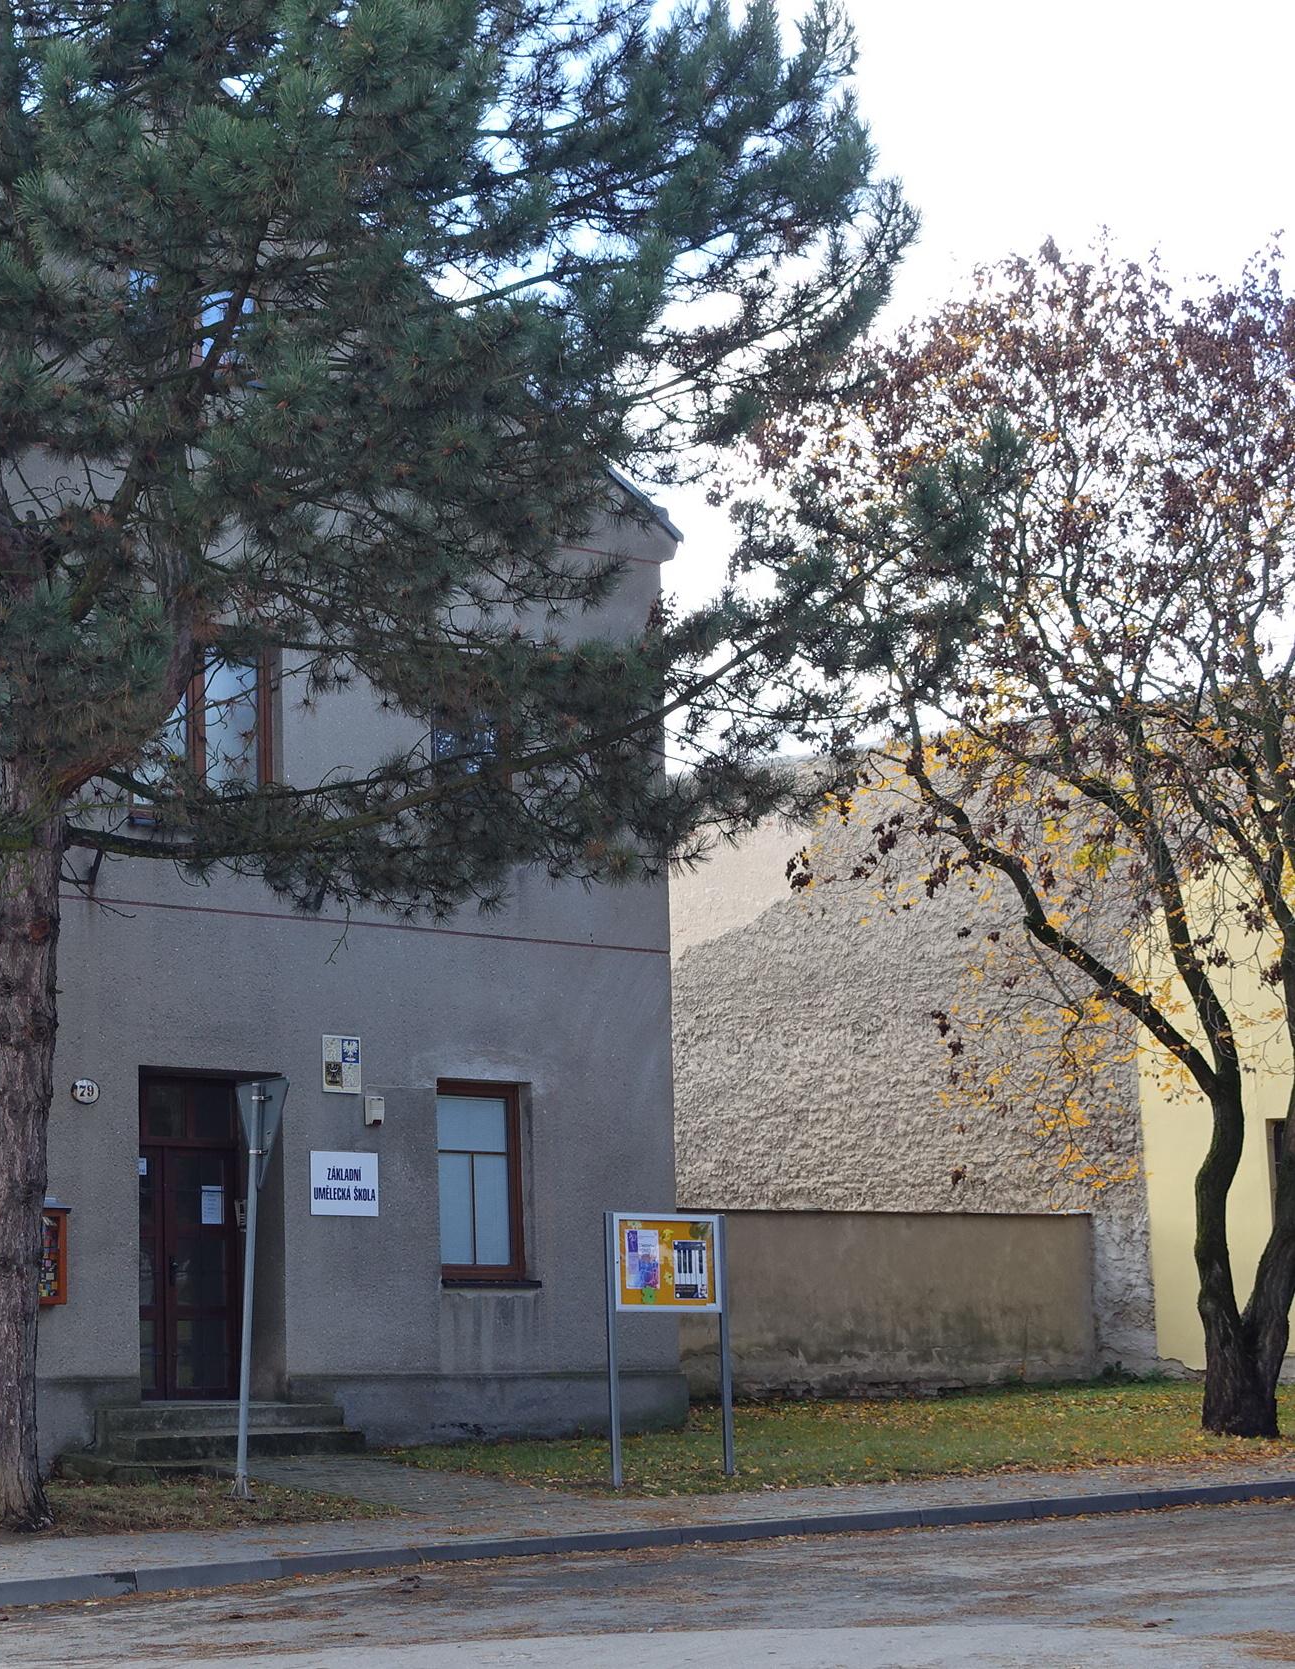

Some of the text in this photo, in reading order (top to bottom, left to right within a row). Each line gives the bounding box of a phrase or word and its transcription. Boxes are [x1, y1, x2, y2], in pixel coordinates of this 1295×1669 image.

[327, 1166, 362, 1181] ZÁKLADNÍ
[314, 1185, 376, 1201] UMĚLECKÁ ŠKOLA
